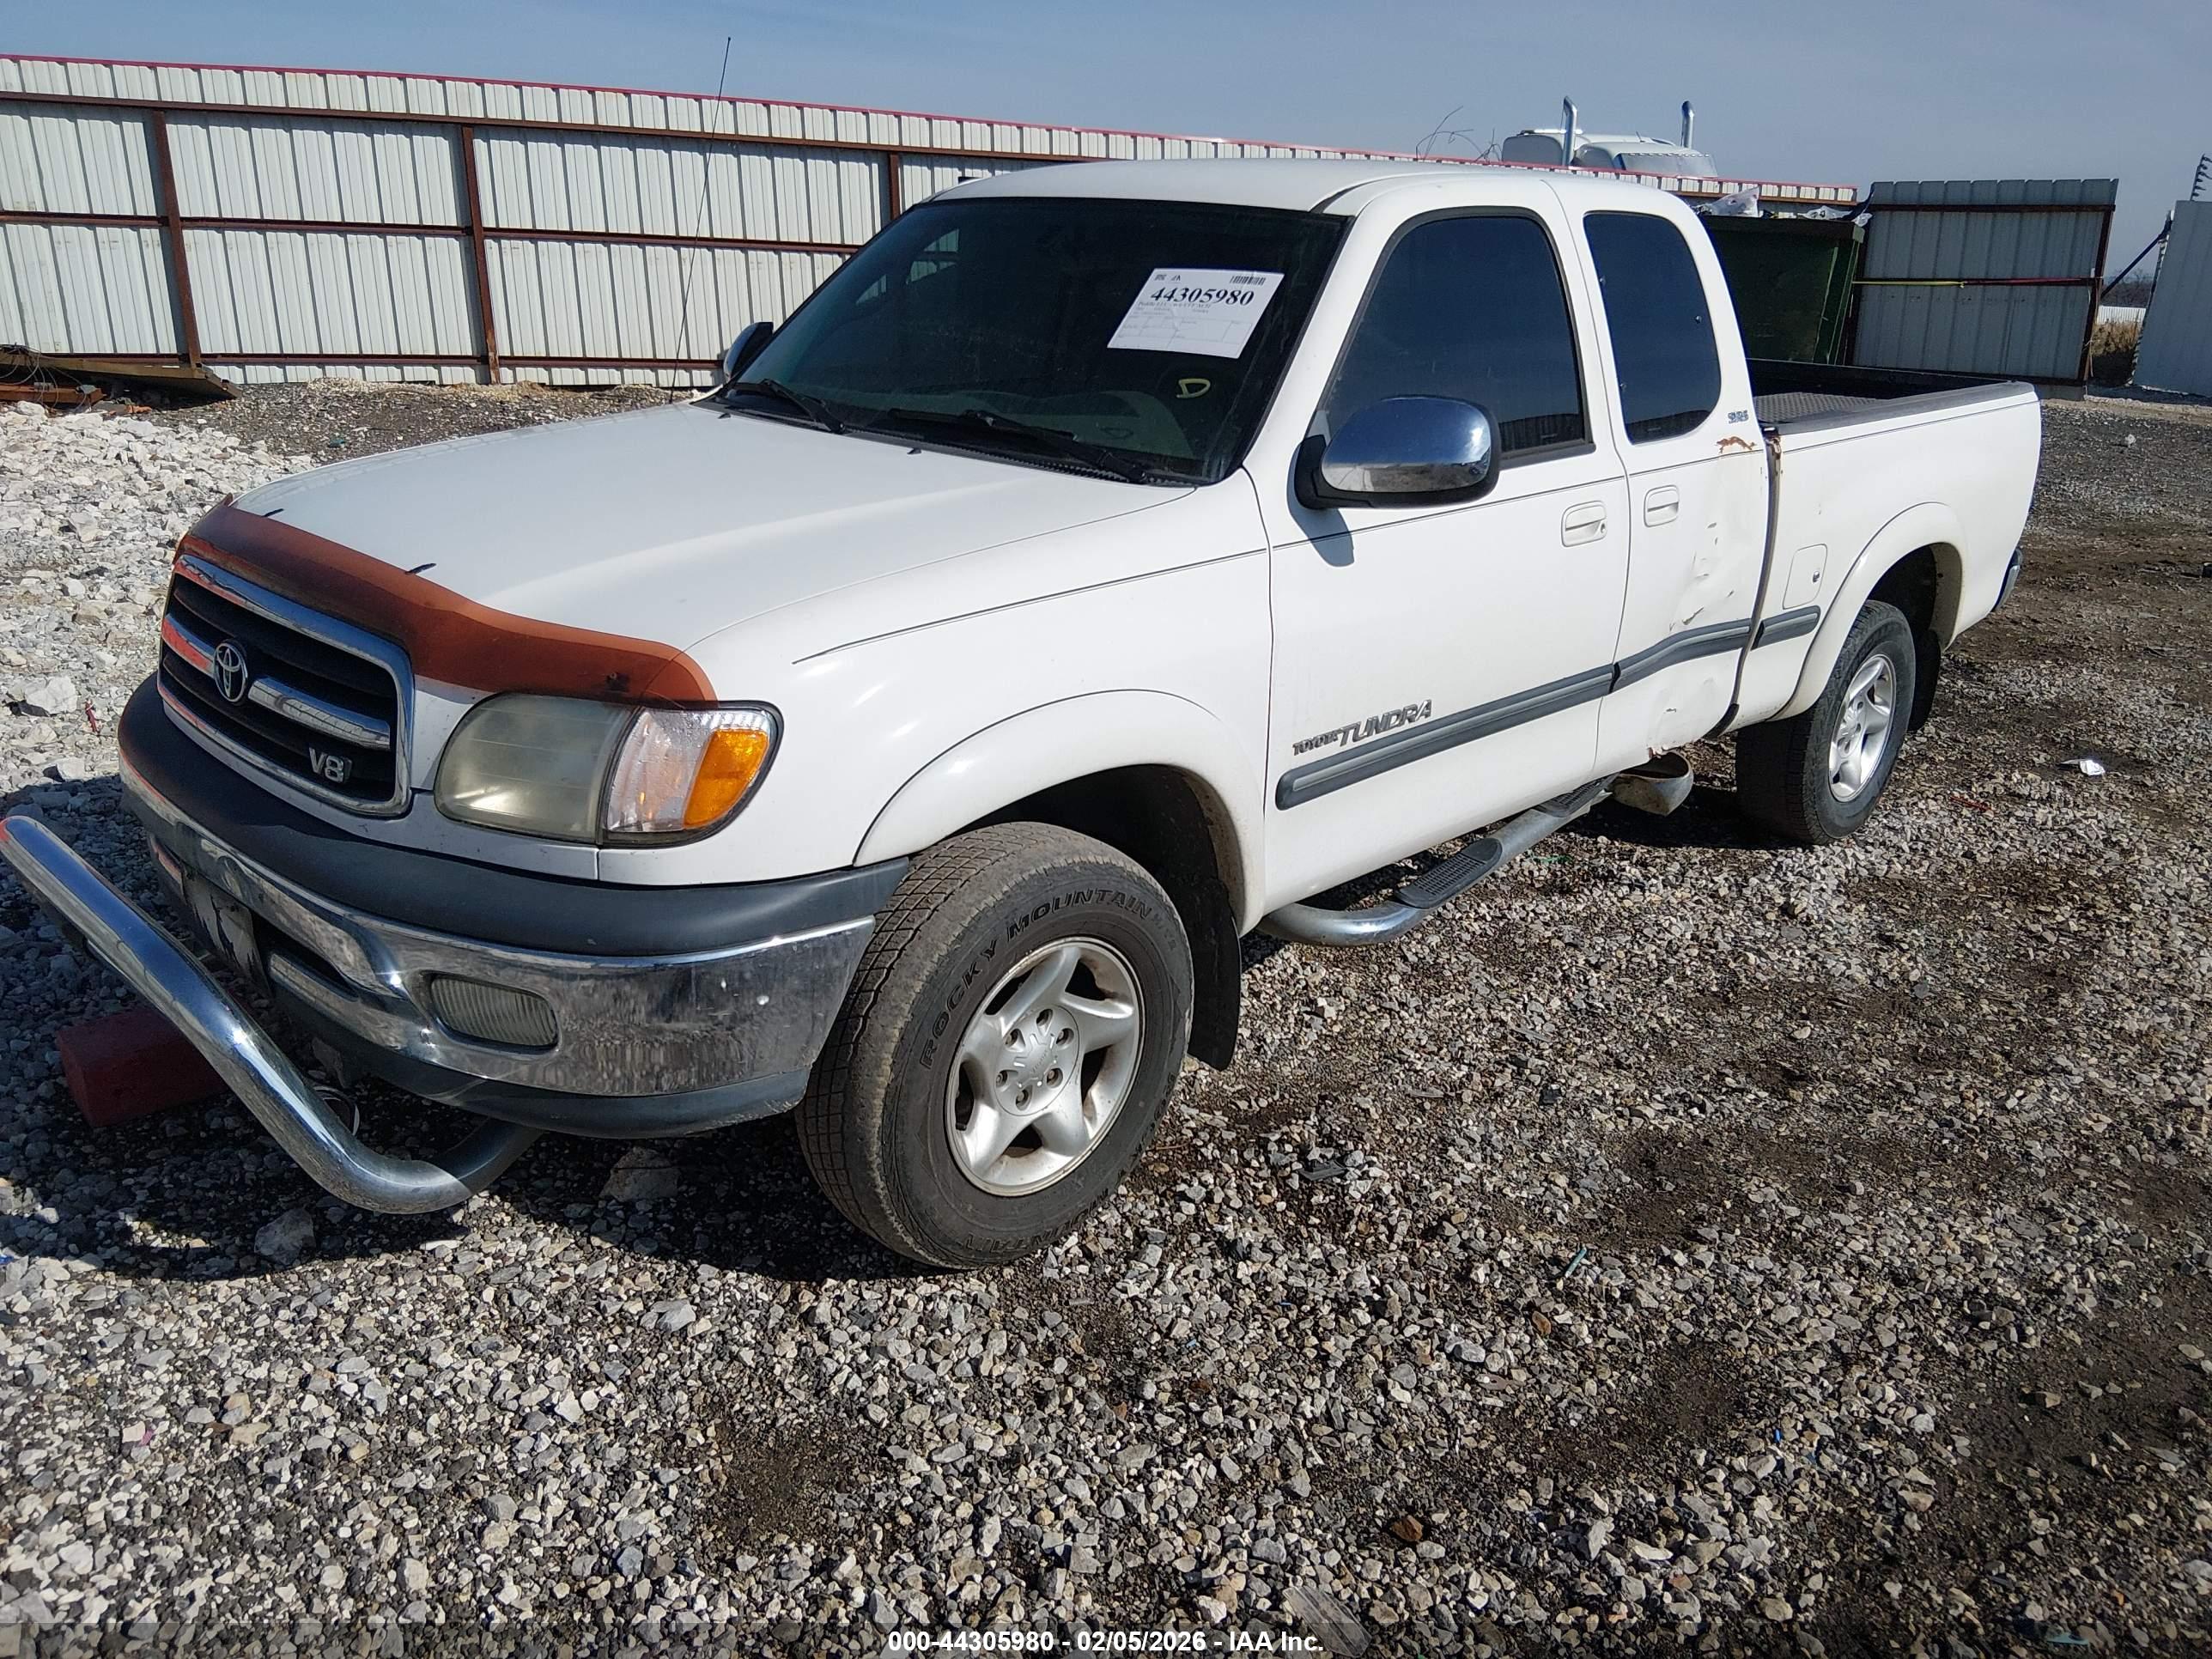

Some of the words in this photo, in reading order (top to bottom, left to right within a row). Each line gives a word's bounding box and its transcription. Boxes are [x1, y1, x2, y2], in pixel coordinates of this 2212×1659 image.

[1150, 287, 1255, 307] 44305980
[1176, 378, 1211, 399] D
[1339, 699, 1432, 747] TUNDRA
[309, 747, 347, 783] V8
[919, 939, 998, 1069] ROCKY
[1006, 887, 1153, 942] MOUNTAIN
